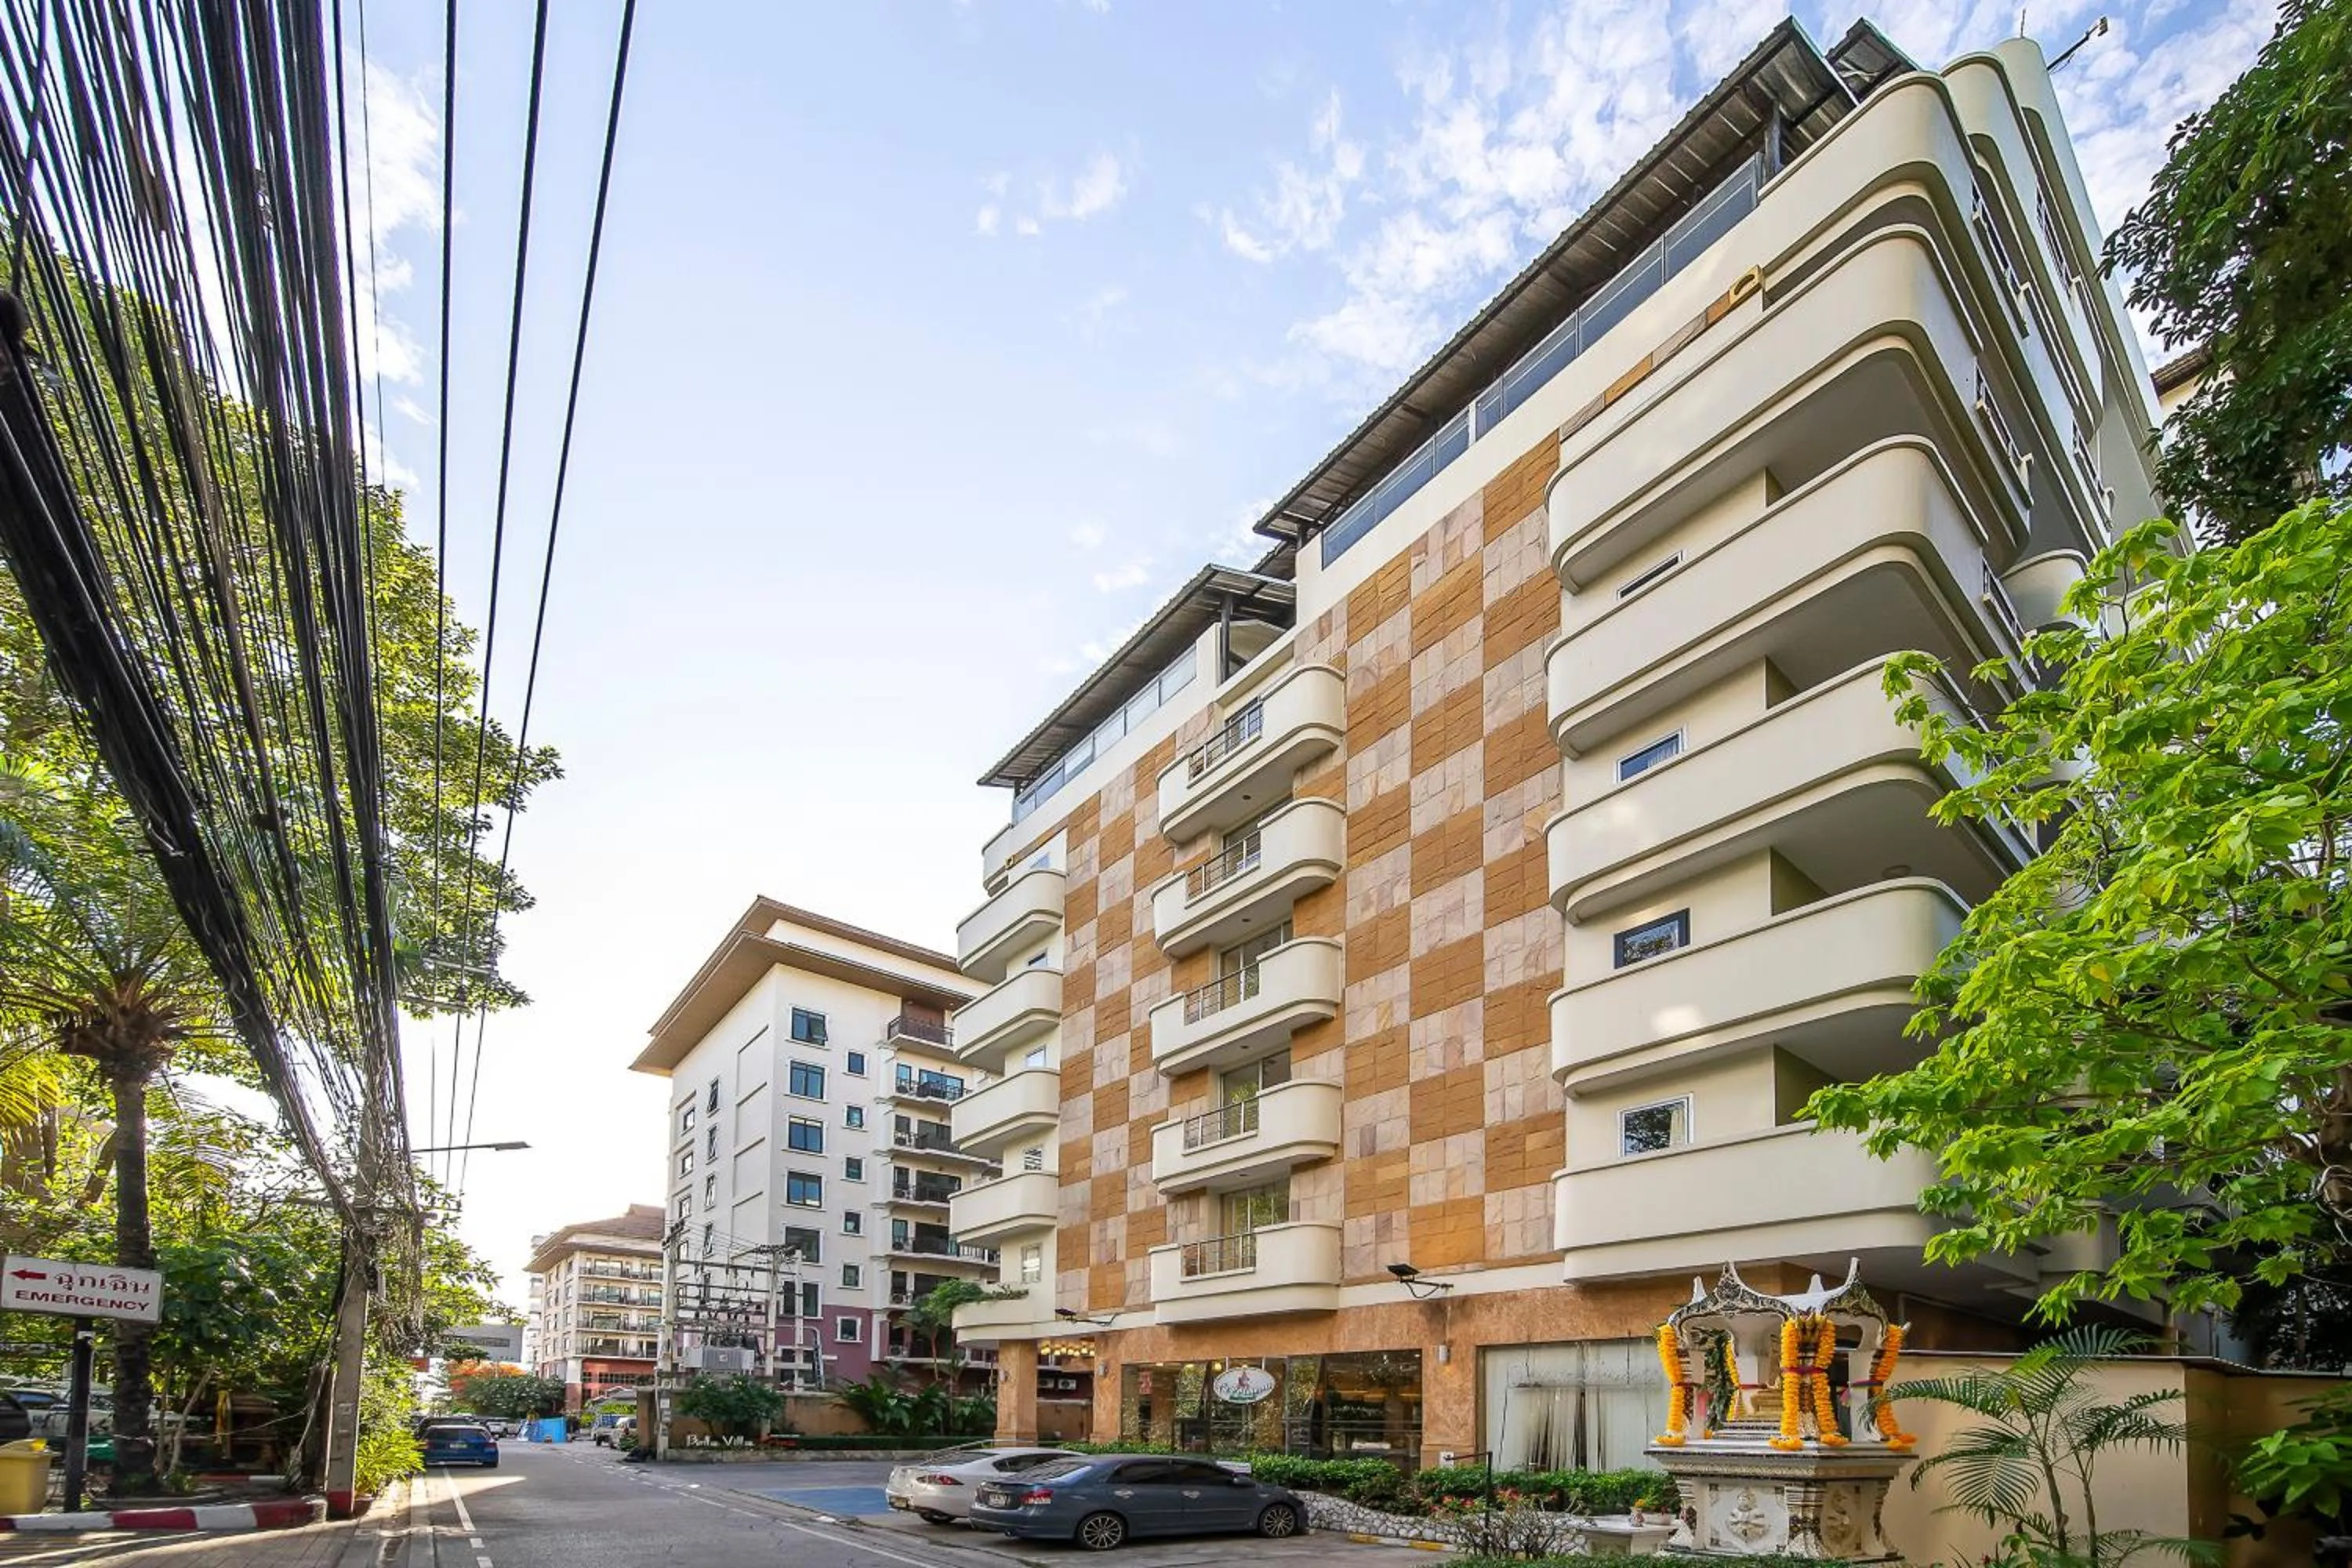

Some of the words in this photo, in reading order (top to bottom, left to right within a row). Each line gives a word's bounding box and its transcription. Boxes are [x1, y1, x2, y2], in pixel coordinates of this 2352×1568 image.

[54, 1273, 150, 1294] ฉุกเฉิน
[16, 1290, 150, 1311] EMERGENCY
